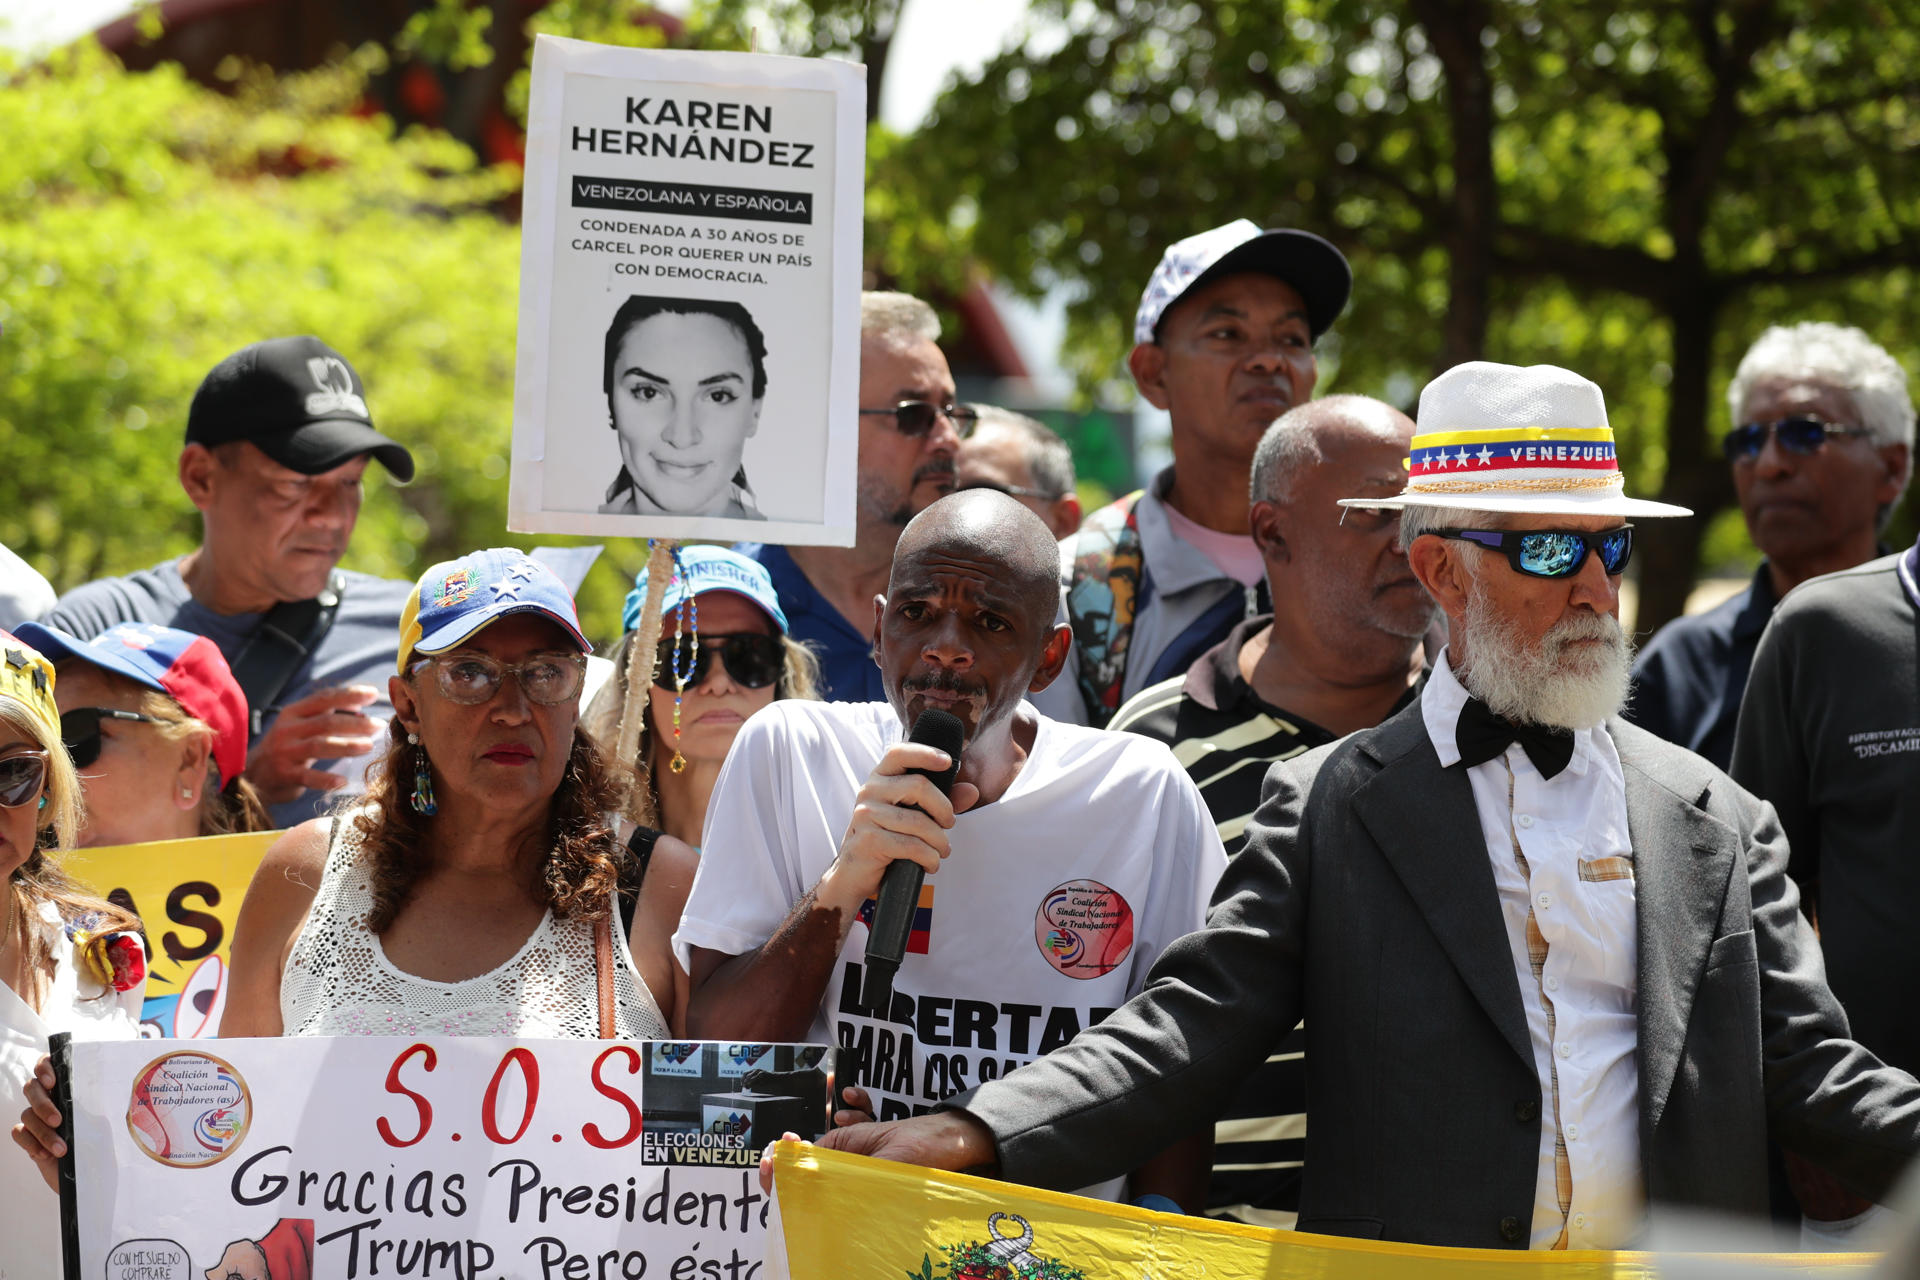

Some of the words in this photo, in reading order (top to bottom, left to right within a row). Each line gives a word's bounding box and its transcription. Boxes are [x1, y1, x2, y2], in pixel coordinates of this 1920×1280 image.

[625, 96, 773, 134] KAREN
[571, 126, 815, 169] HERNÁNDEZ
[577, 183, 696, 206] VENEZOLANA
[698, 193, 712, 207] Y
[715, 191, 807, 214] ESPAÑOLA
[580, 219, 687, 239] CONDENADA
[690, 227, 702, 240] A
[706, 228, 728, 241] 30
[731, 229, 778, 245] AÑOS
[782, 234, 805, 247] DE
[571, 239, 636, 255] CARCEL
[639, 244, 674, 257] POR
[678, 247, 745, 263] QUERER
[748, 251, 772, 265] UN
[776, 253, 813, 268] PAÍS
[614, 262, 650, 276] CON
[654, 264, 769, 285] DEMOCRACIA.
[1509, 445, 1617, 462] VENEZUELA
[687, 562, 760, 592] INISHER
[1056, 907, 1086, 918] Sindical
[1088, 909, 1123, 918] Nacional
[1072, 897, 1107, 907] Coalición
[1070, 920, 1119, 931] Trabajadores
[838, 961, 1118, 1056] LBERTA
[163, 1070, 209, 1080] Coalición
[143, 1083, 183, 1093] Sindical
[184, 1082, 230, 1092] Nacional
[137, 1097, 149, 1107] de
[152, 1096, 215, 1108] Trabajadores
[216, 1095, 235, 1106] (as)
[643, 1131, 746, 1149] ELECCIONES
[643, 1146, 669, 1163] EN
[672, 1149, 763, 1166] VENEZUE
[231, 1145, 468, 1218] Gracias
[113, 1253, 131, 1265] CON
[133, 1252, 144, 1265] MI
[146, 1251, 180, 1265] SUELDO
[522, 1236, 648, 1280] Pero
